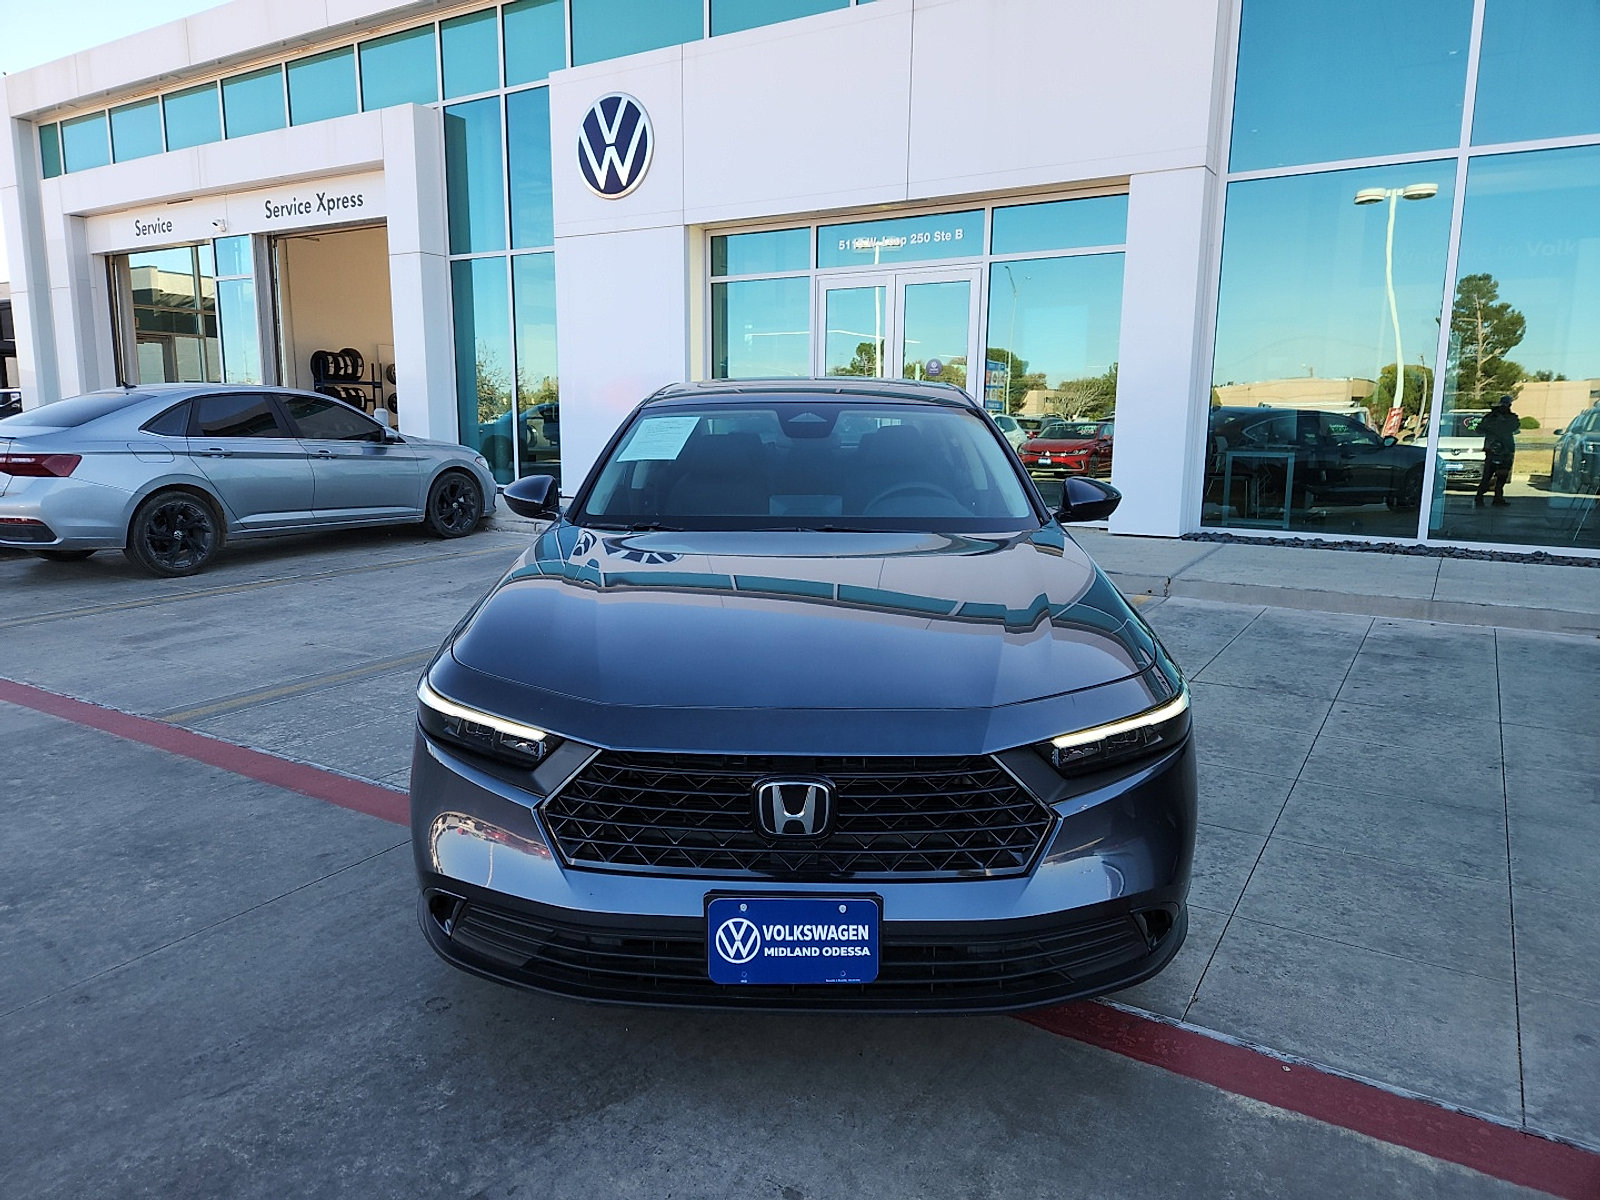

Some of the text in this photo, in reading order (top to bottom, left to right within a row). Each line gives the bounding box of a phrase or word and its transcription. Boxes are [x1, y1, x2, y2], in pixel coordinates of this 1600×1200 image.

[265, 192, 364, 219] Service Xpress
[135, 217, 173, 237] Service
[838, 237, 866, 250] 511
[910, 232, 931, 244] 250
[934, 230, 952, 242] Ste
[955, 228, 964, 240] B
[762, 925, 869, 941] VOLKSWAGEN
[764, 946, 871, 957] MIDLAND ODESSA
